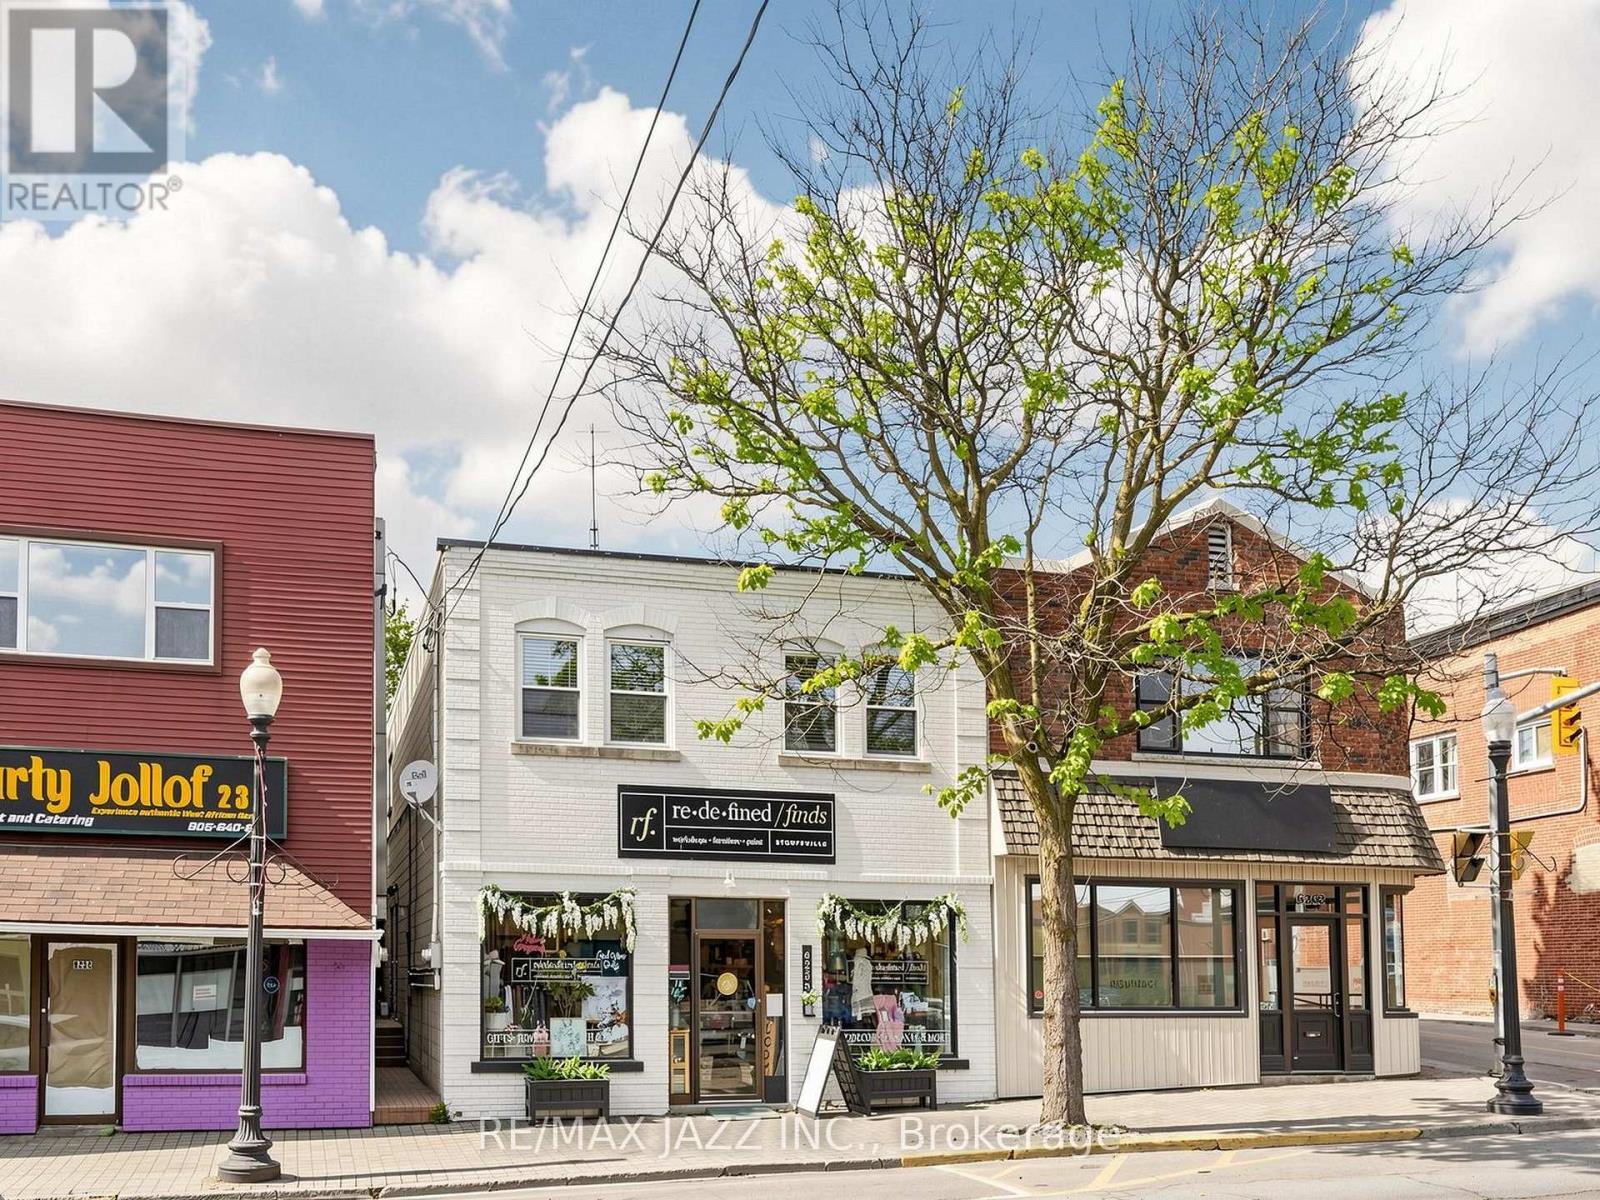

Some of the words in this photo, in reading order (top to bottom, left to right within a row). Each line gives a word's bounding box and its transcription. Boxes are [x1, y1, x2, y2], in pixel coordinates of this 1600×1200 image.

[89, 760, 213, 808] Jollof
[8, 813, 34, 824] and
[35, 813, 95, 827] Catering
